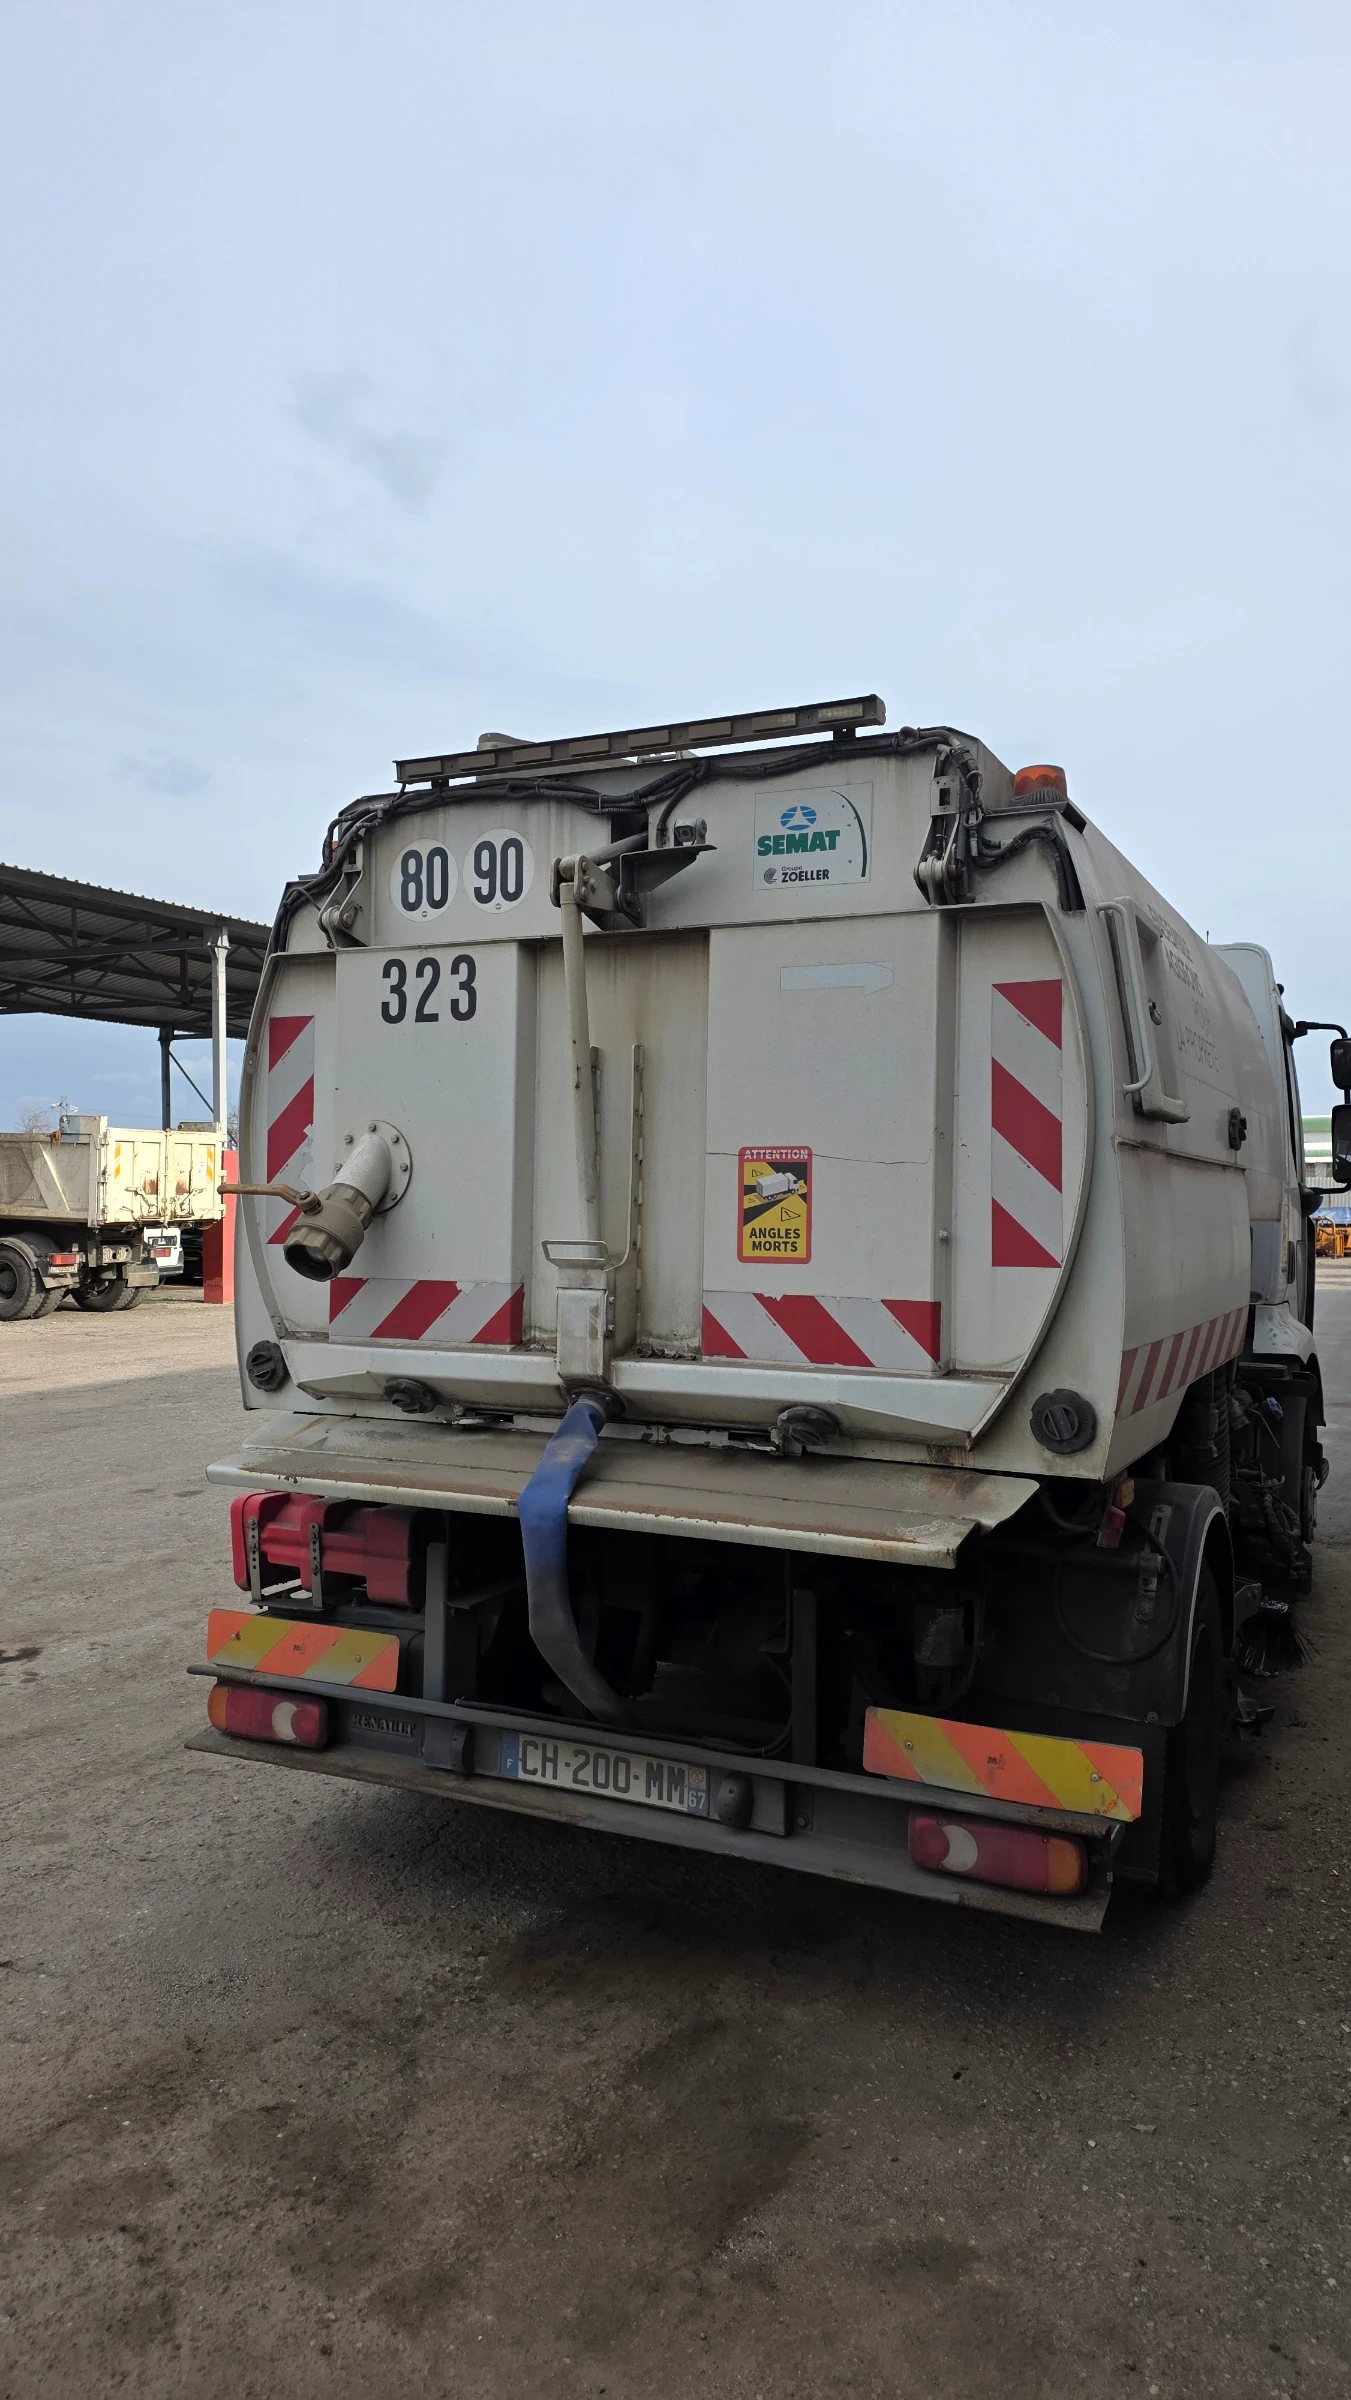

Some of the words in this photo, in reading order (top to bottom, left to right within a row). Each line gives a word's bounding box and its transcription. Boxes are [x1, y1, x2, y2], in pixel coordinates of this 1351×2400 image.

[757, 830, 840, 856] SEMAT
[401, 847, 448, 912] 80
[474, 838, 523, 904] 90
[781, 869, 830, 883] ZOELLER
[381, 954, 477, 1024] 323
[744, 1149, 808, 1160] ATTENTION
[749, 1227, 801, 1239] ANGLES
[751, 1240, 798, 1252] MORTS
[352, 1713, 416, 1738] RENAULT
[506, 1758, 514, 1769] F
[688, 1790, 706, 1809] 67
